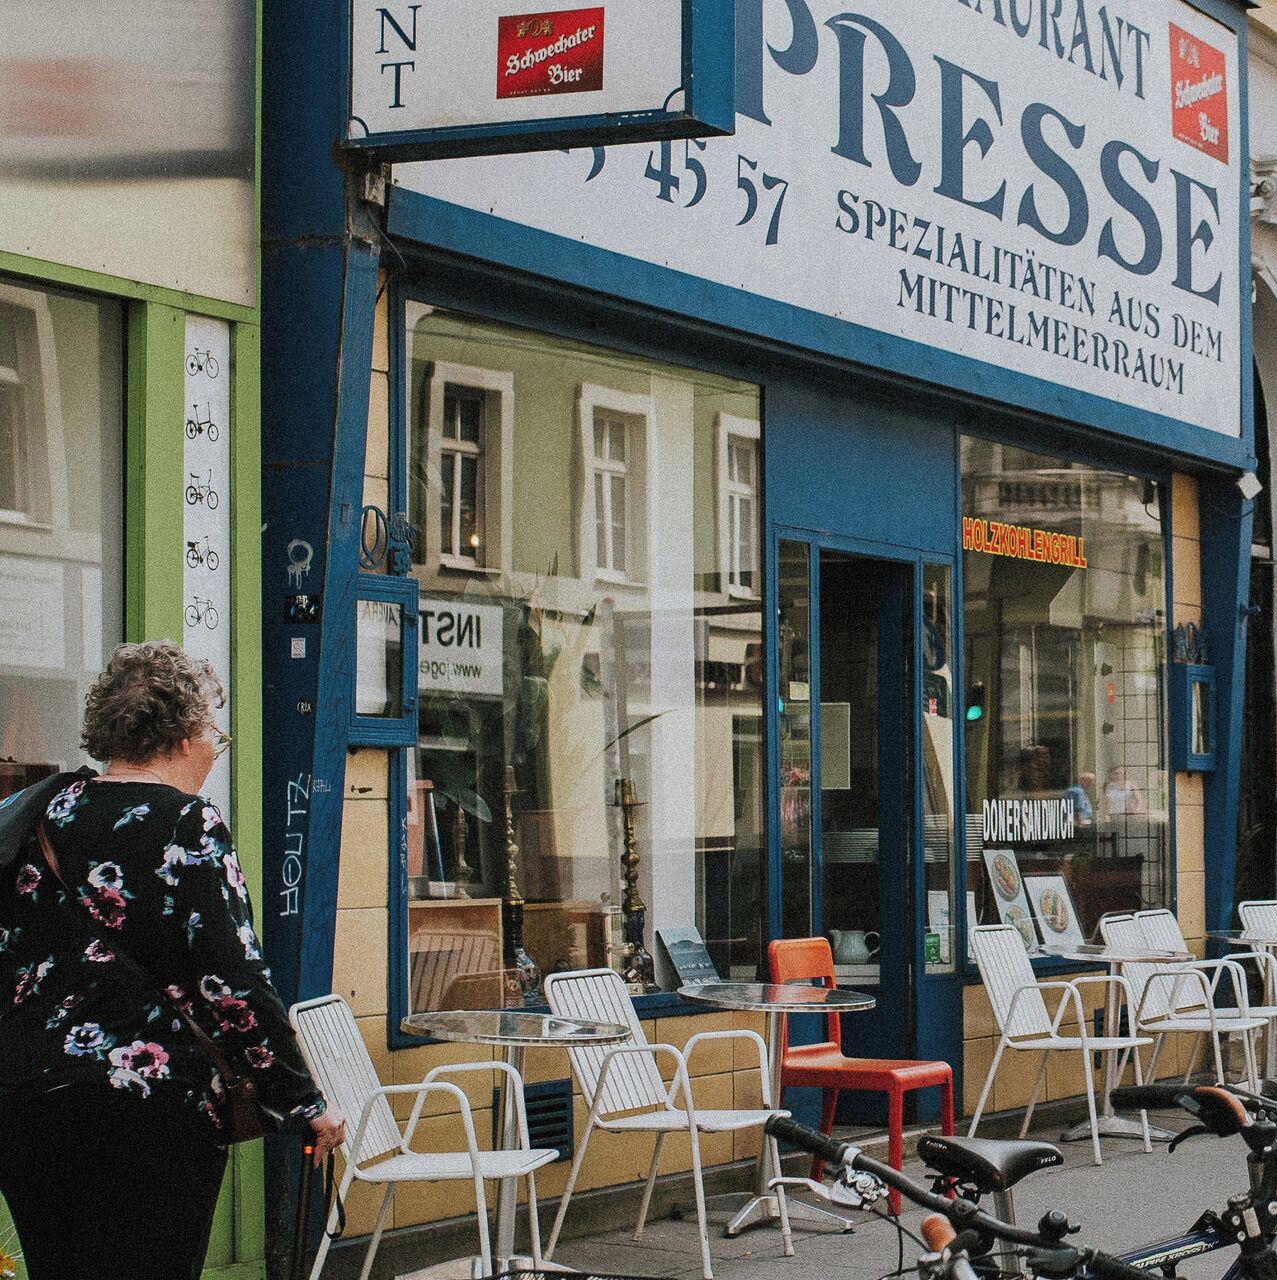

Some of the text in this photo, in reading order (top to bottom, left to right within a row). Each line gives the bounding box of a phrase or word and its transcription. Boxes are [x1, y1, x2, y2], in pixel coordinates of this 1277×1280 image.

[505, 25, 597, 77] Schwechater
[548, 63, 583, 85] Bier
[735, 153, 789, 246] 57
[835, 188, 1223, 363] SPEZIALITÄTEN AUS DEM
[896, 268, 1185, 395] MITTELMEERRAUM
[963, 517, 1087, 568] HOLZKOHLENGRILL
[1022, 798, 1074, 841] SANDWICH
